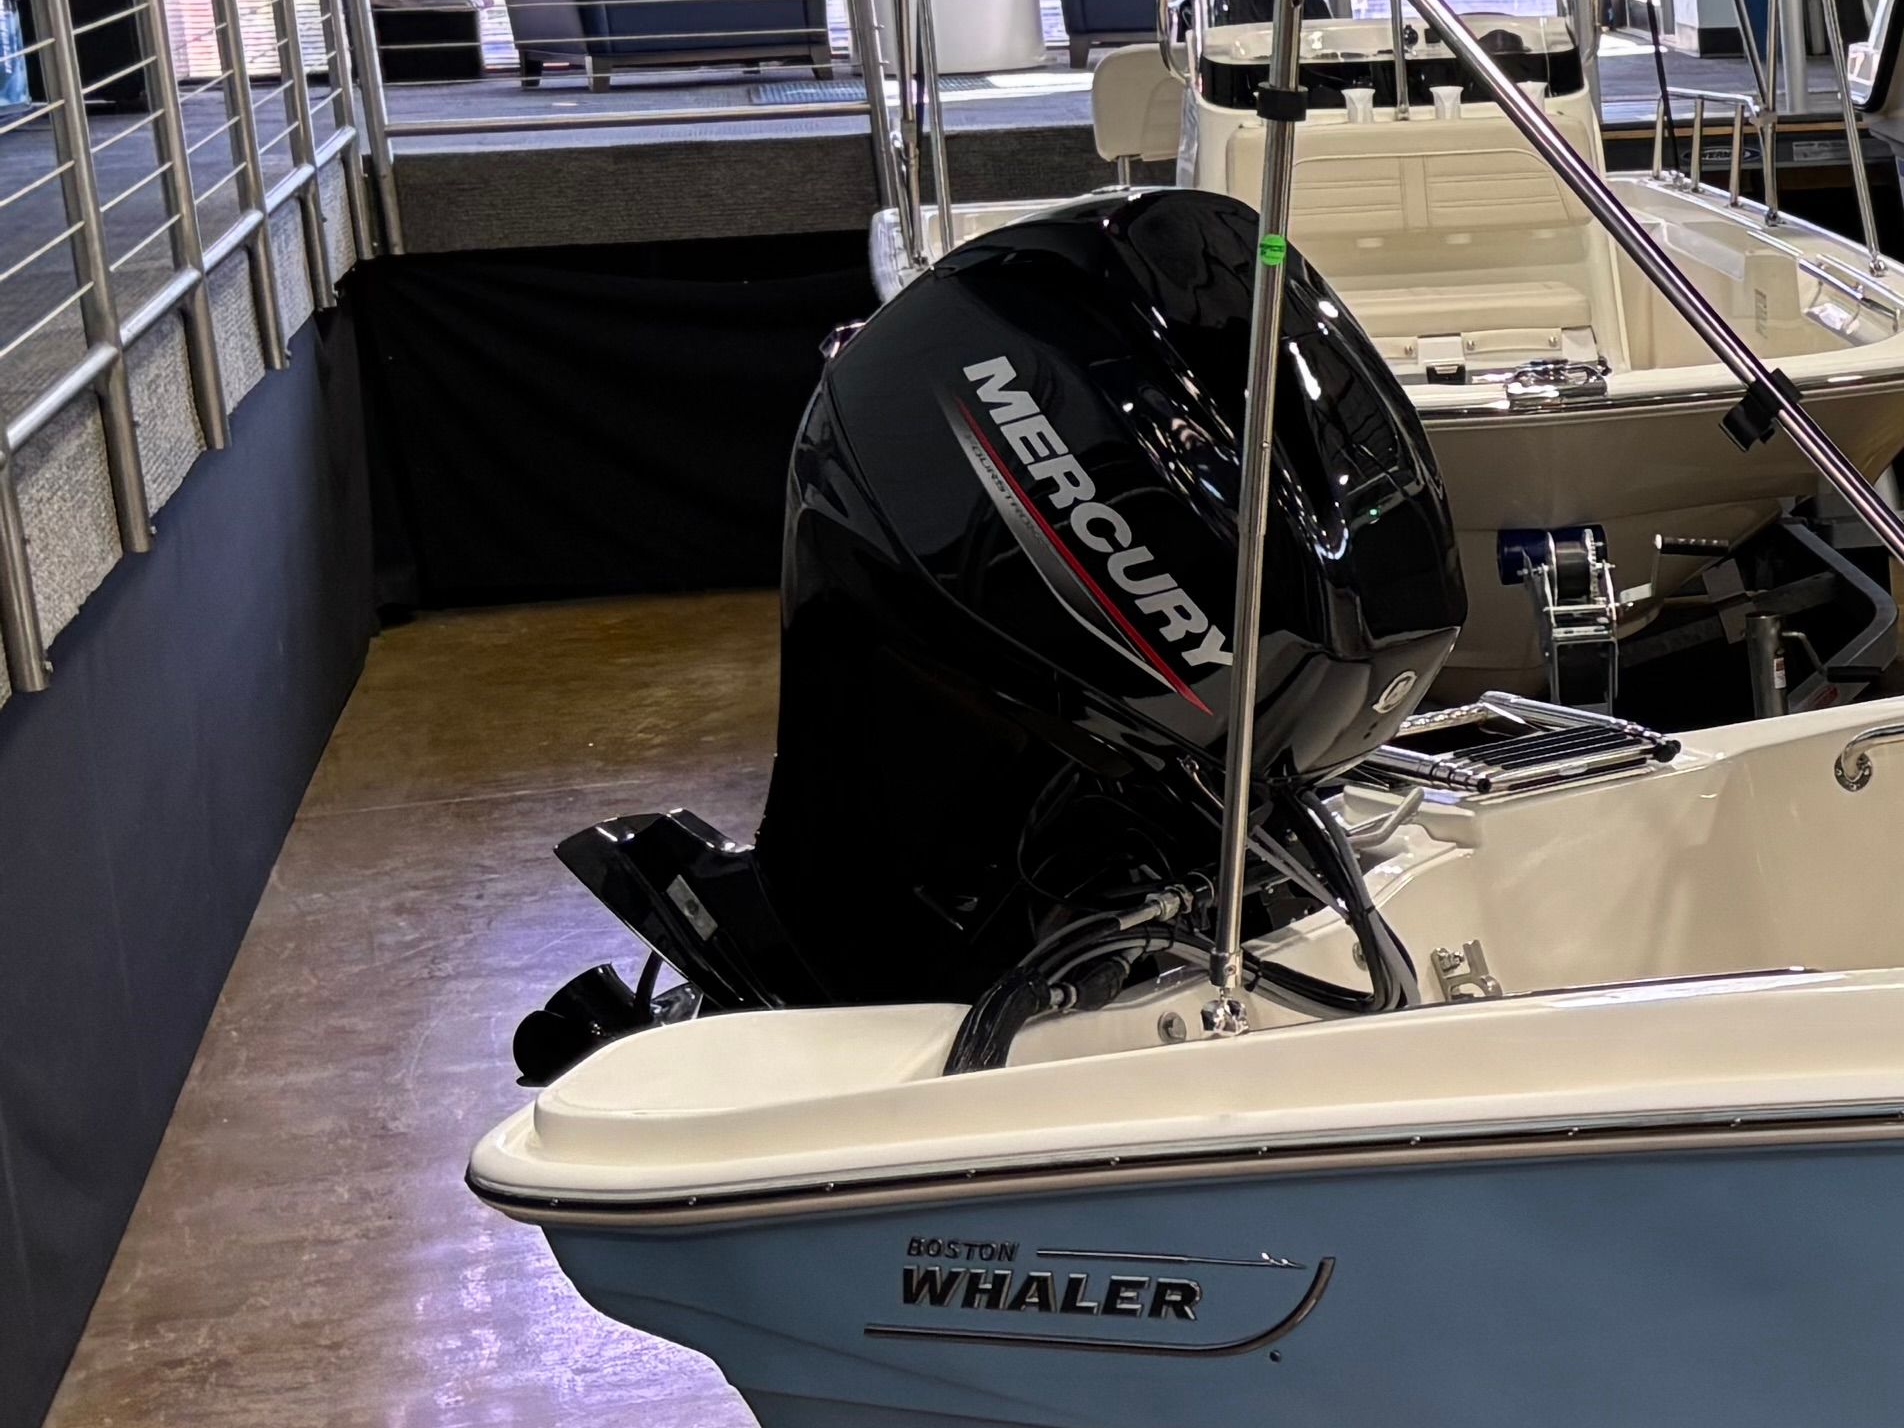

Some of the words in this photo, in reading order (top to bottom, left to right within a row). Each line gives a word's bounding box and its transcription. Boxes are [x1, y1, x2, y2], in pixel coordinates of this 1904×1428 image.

[963, 355, 1234, 667] MERCURY
[906, 1235, 1021, 1263] BOSTON
[902, 1265, 1203, 1321] WHALER
